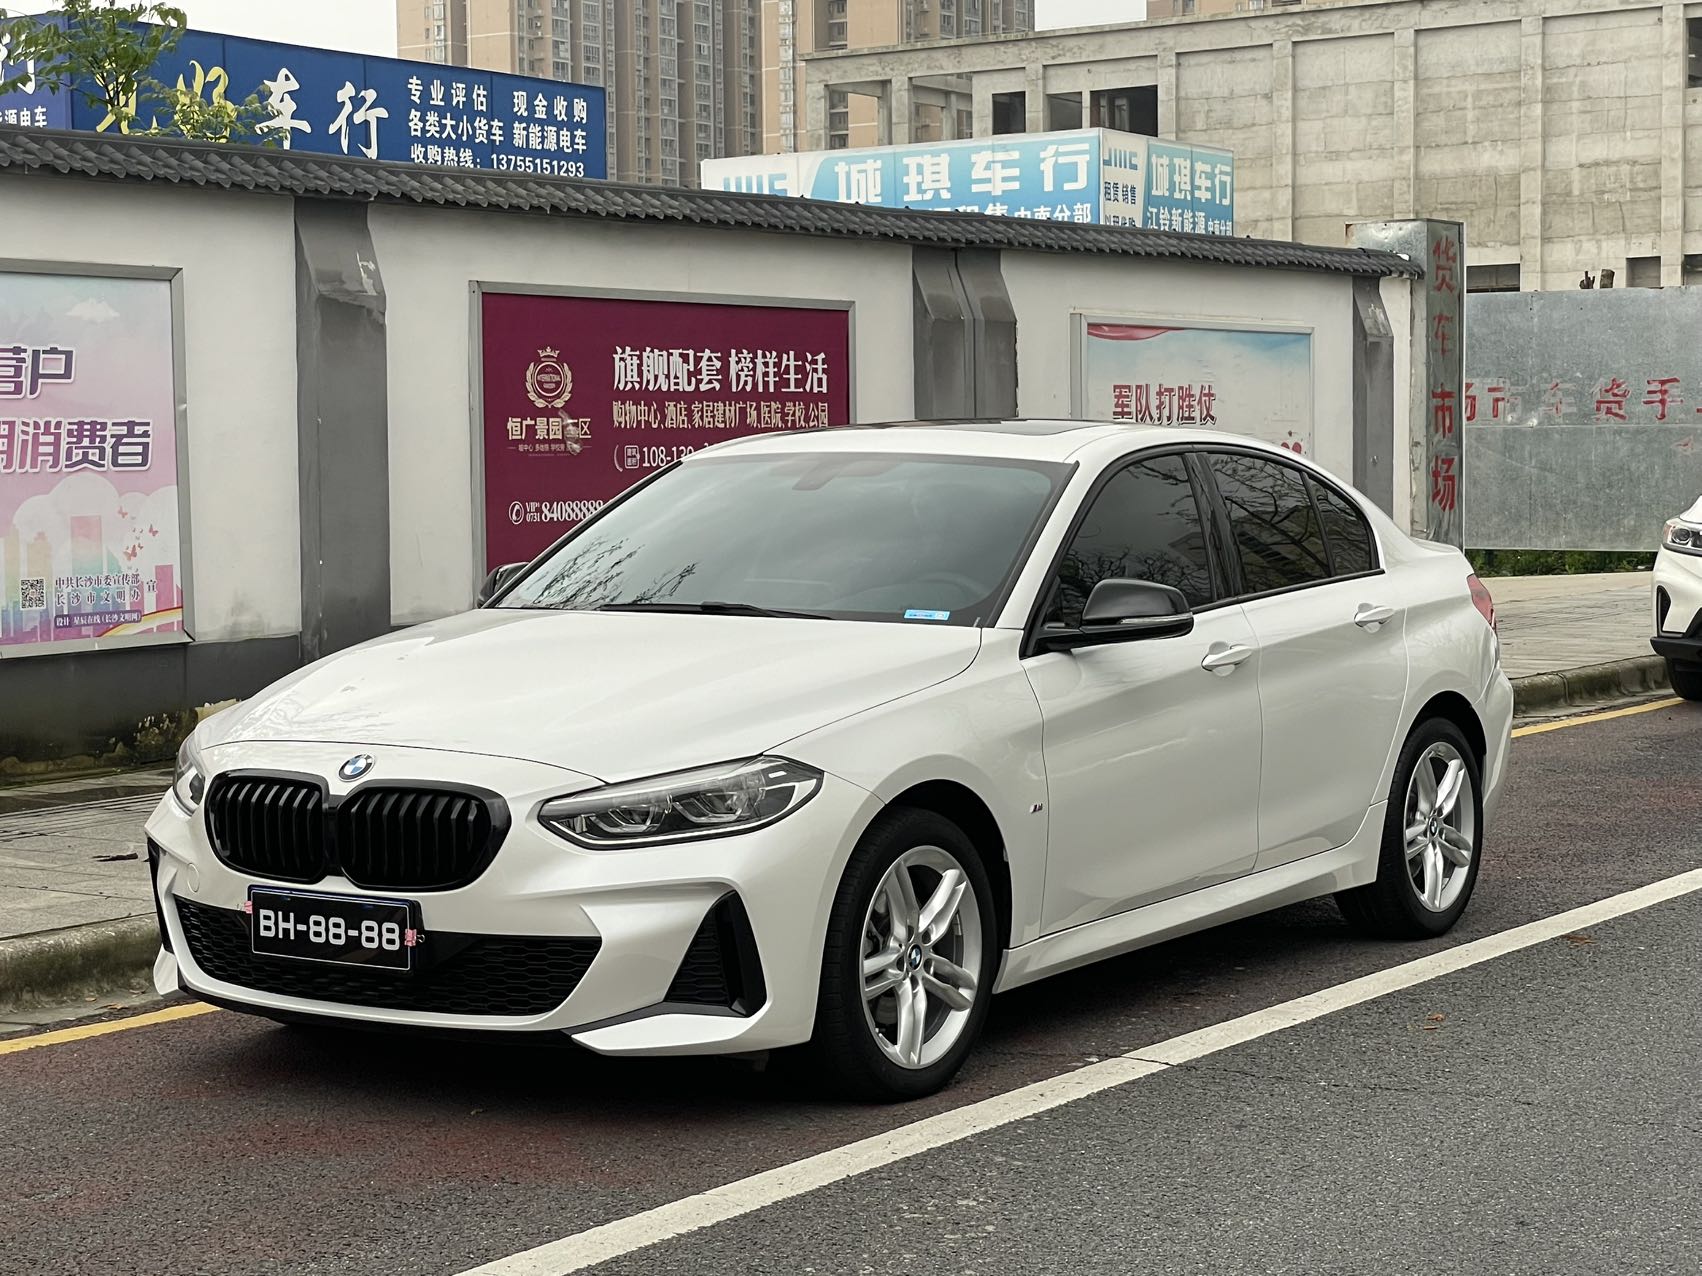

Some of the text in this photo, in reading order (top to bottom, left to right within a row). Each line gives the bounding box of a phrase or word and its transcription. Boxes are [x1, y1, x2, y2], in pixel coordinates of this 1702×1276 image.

[0, 105, 48, 128] 源电车
[407, 75, 588, 125] 专业评估 现金收购
[408, 108, 588, 155] 各类大小货车 新能源电车
[490, 153, 585, 178] 13755151293
[834, 142, 1091, 205] 城琪车行
[1151, 153, 1232, 207] 城琪车行
[1146, 205, 1206, 235] 江铃新能源
[612, 345, 828, 394] 旗舰配套 榜样生活
[1112, 383, 1216, 426] 军队打胜仗
[506, 416, 592, 440] 恒广景园区
[55, 573, 141, 590] 中共长沙市委宣传部
[56, 616, 70, 628] 设计
[258, 908, 400, 951] BH-88-88
